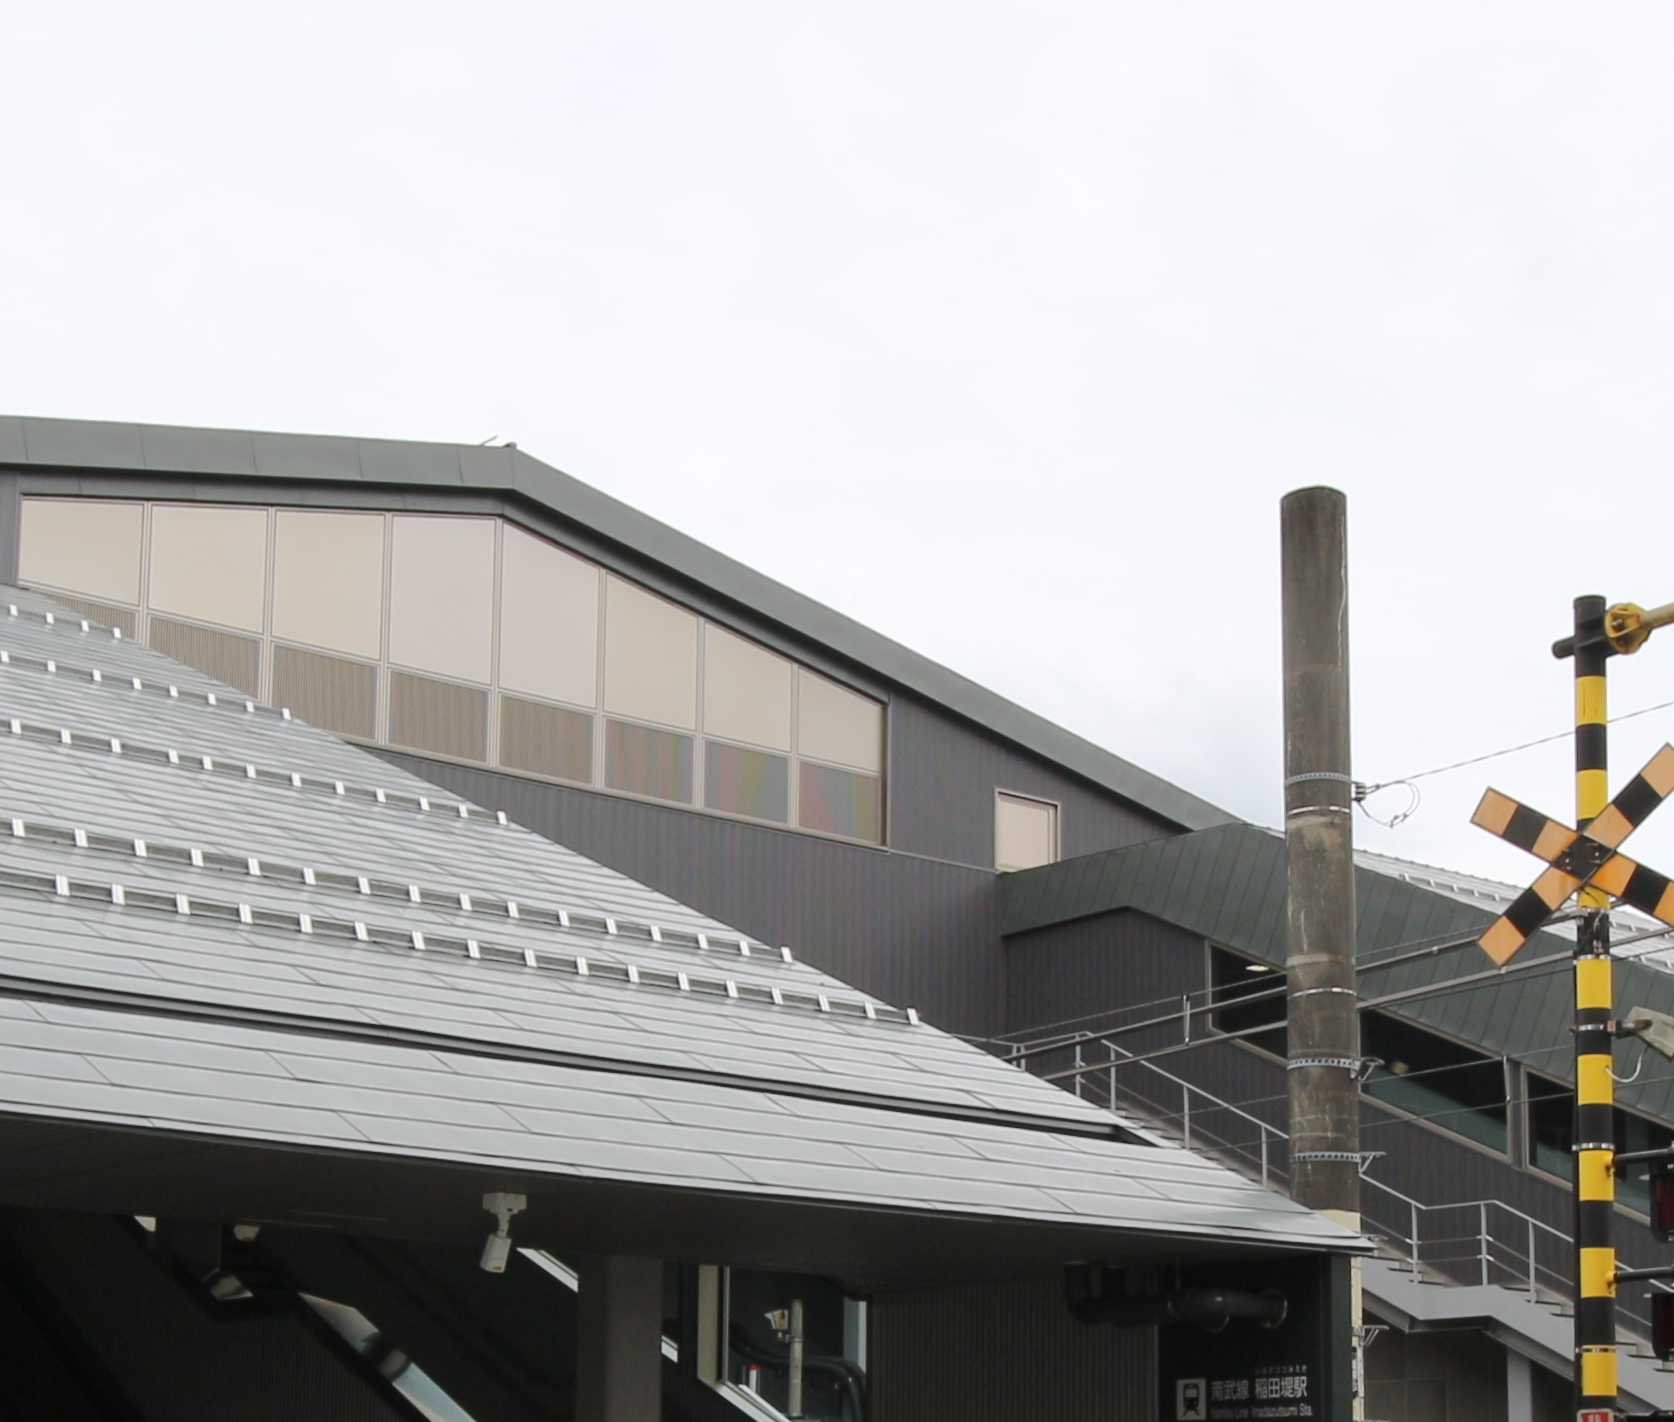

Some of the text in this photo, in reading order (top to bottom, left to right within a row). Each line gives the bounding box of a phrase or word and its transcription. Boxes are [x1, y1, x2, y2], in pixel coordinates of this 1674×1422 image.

[1211, 1376, 1308, 1400] 南武線 稲田堤駅
